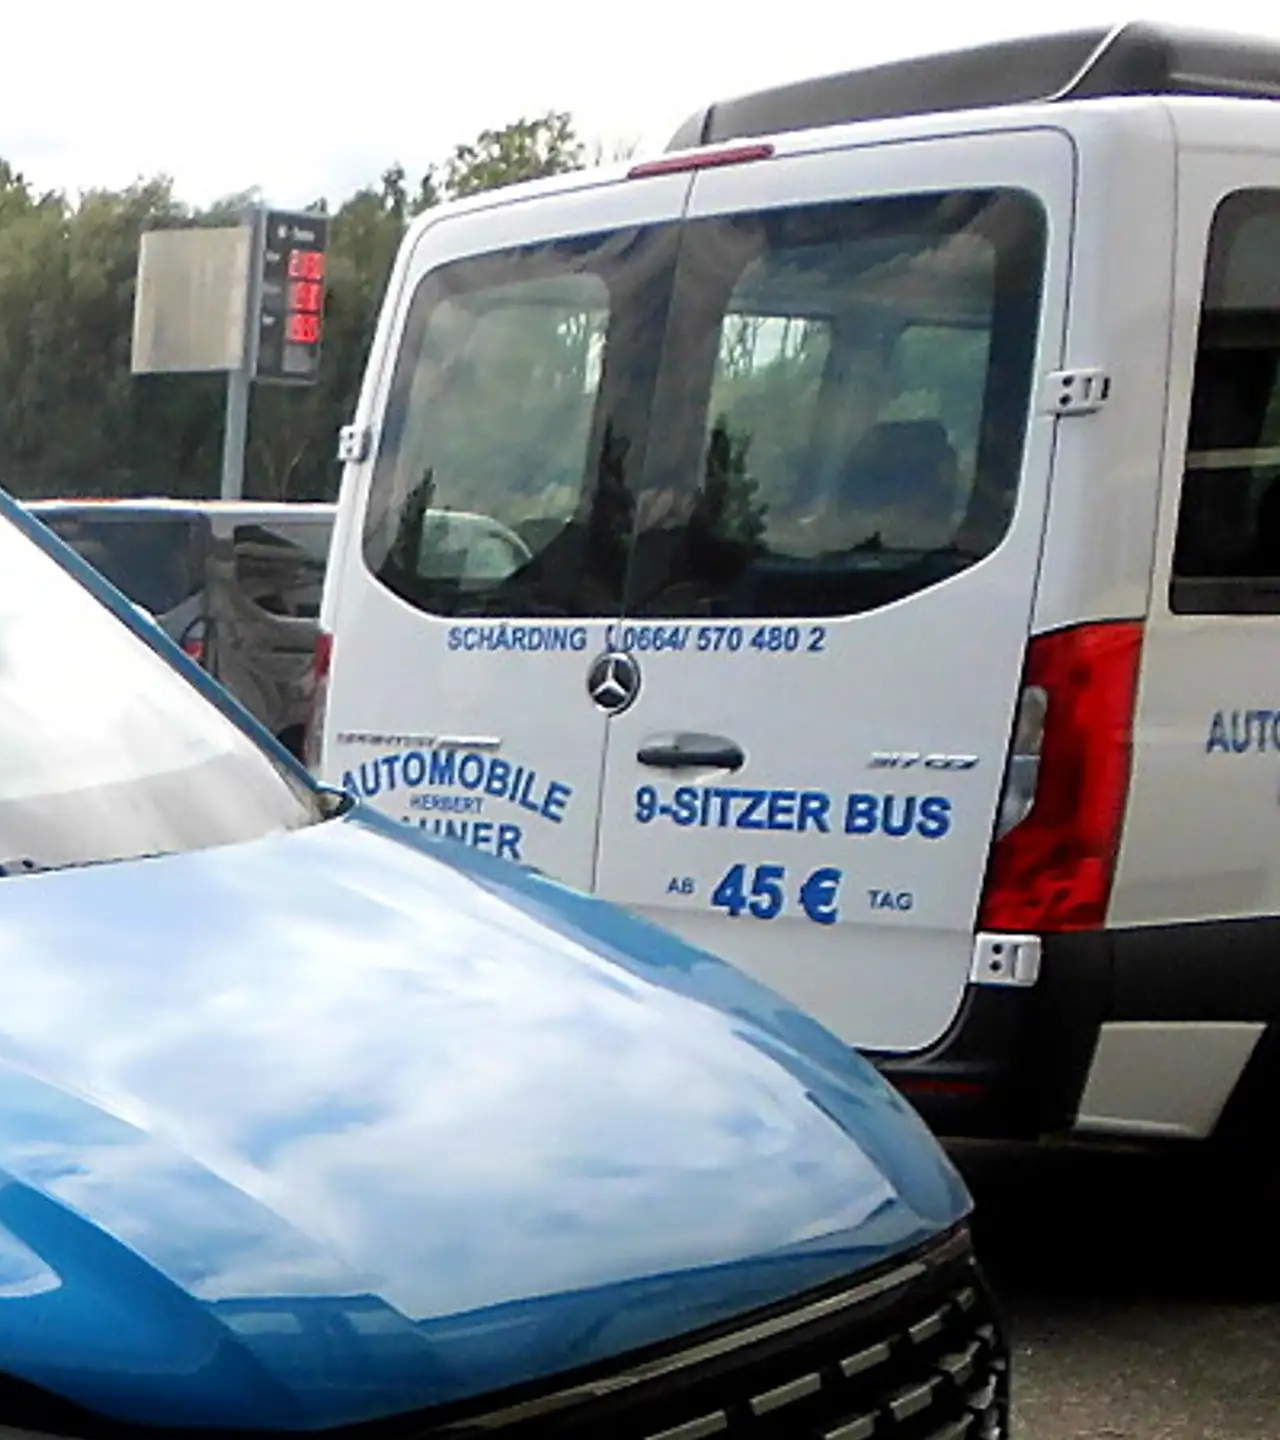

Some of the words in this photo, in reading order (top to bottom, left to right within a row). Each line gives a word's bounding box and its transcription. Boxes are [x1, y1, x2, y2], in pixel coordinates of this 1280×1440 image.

[448, 621, 587, 651] SCHÄRDING
[697, 626, 742, 651] 570
[751, 626, 800, 651] 480
[807, 626, 826, 651] 2
[343, 749, 573, 823] AUTOMOBILE
[410, 794, 484, 814] HERBERT
[636, 785, 832, 833] 9-SITZER
[845, 793, 952, 838] BUS
[667, 877, 694, 894] AB
[711, 864, 785, 919] 45
[798, 867, 842, 925] €
[868, 890, 913, 910] TAG
